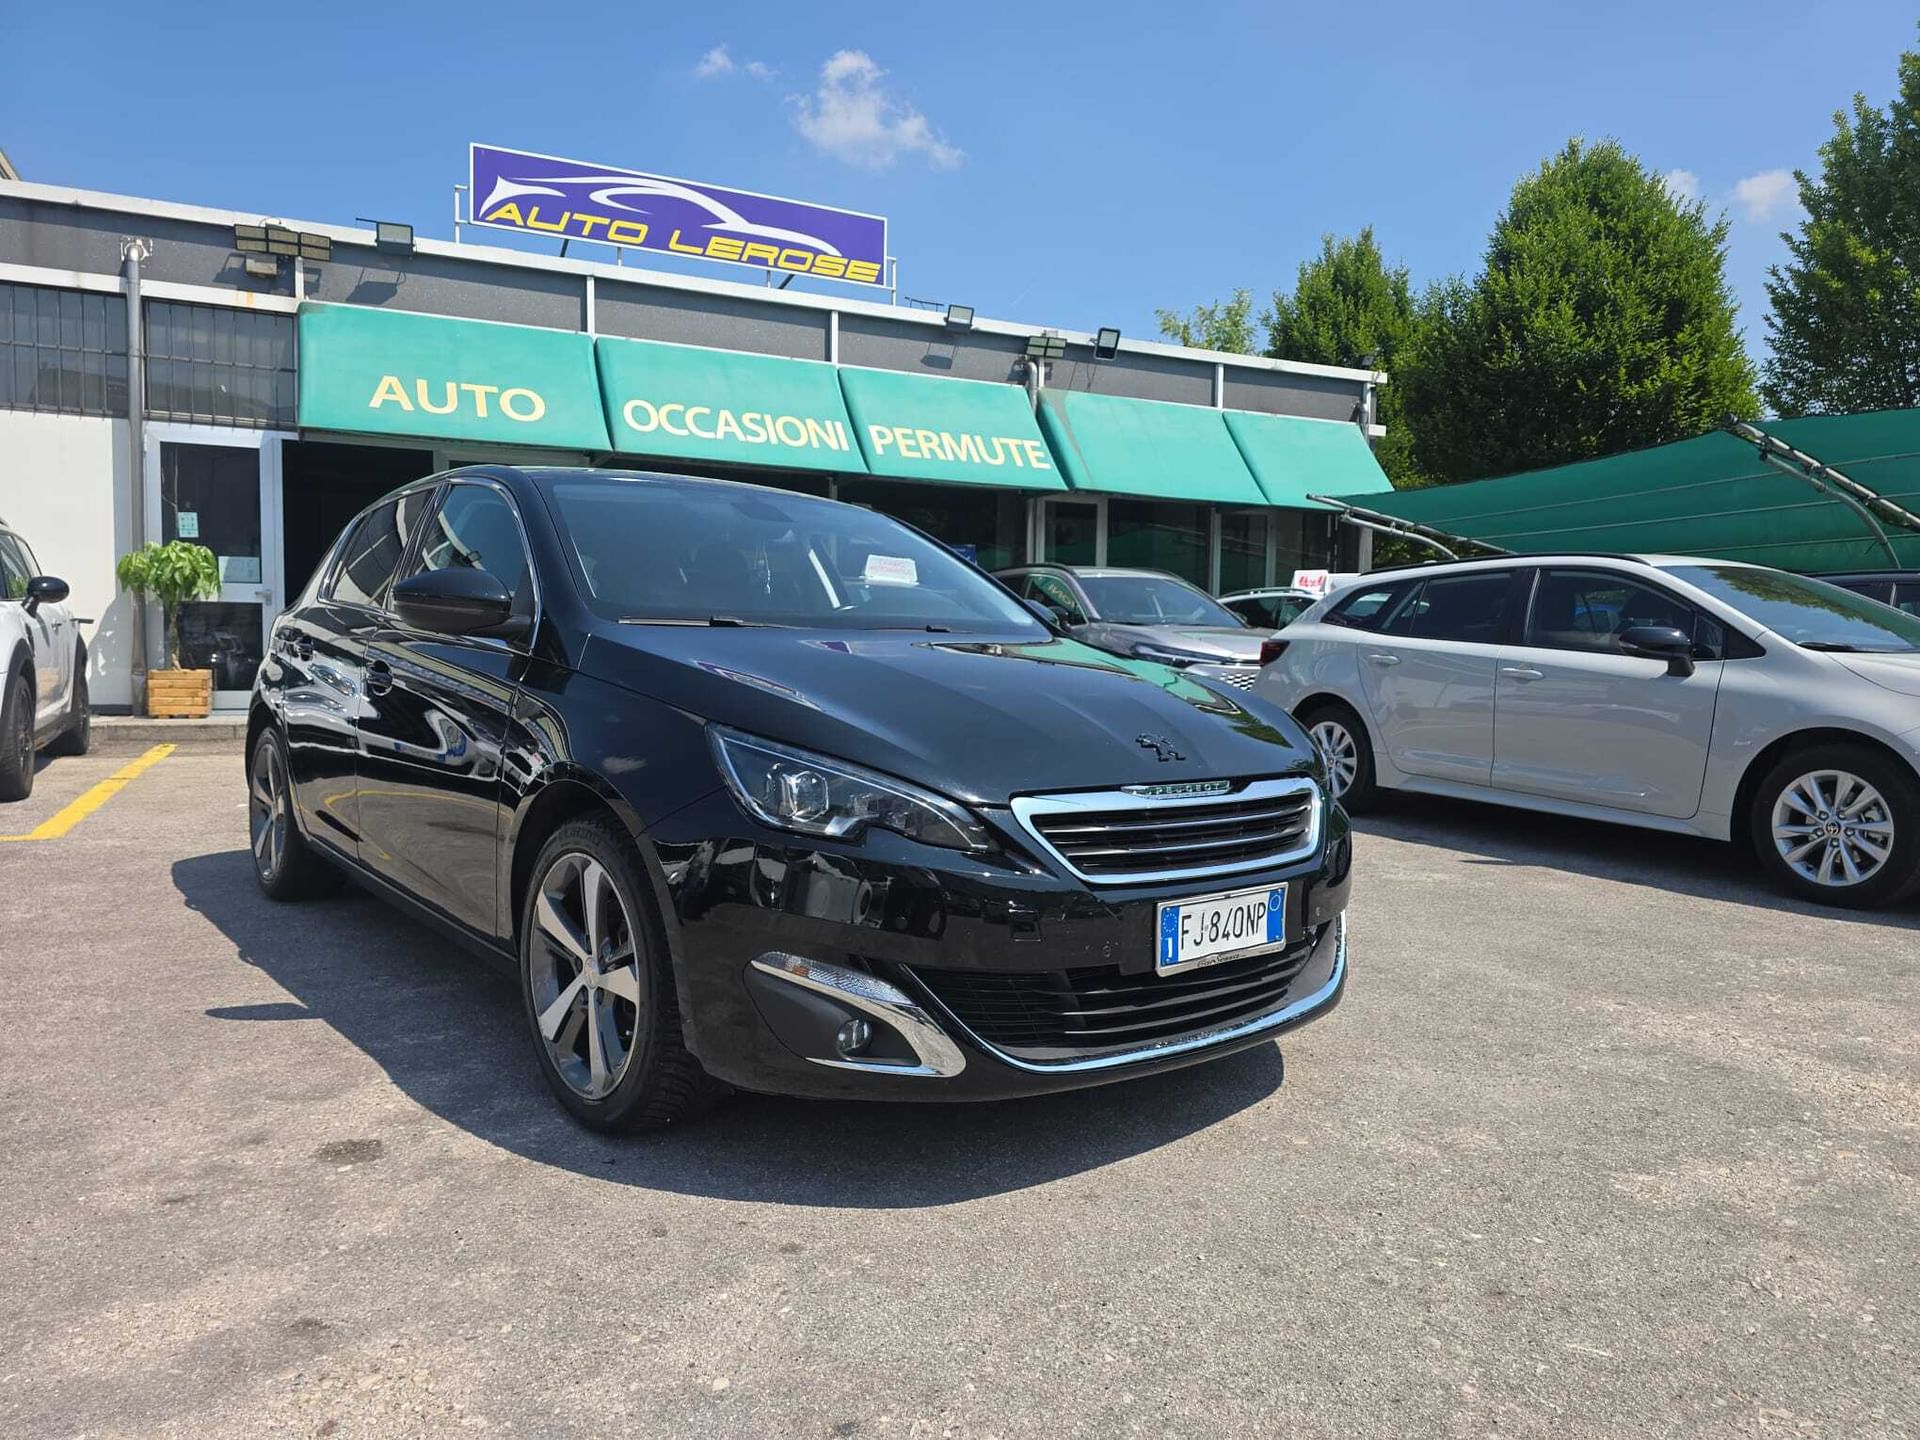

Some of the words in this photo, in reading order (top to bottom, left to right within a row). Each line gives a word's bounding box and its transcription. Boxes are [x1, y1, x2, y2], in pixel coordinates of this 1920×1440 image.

[486, 202, 649, 245] AUTO
[668, 229, 881, 283] LEROSE
[368, 375, 546, 422] AUTO
[623, 399, 849, 451] OCCASIONI
[869, 424, 1051, 469] PERMUTE
[1180, 902, 1267, 950] FJ840NP
